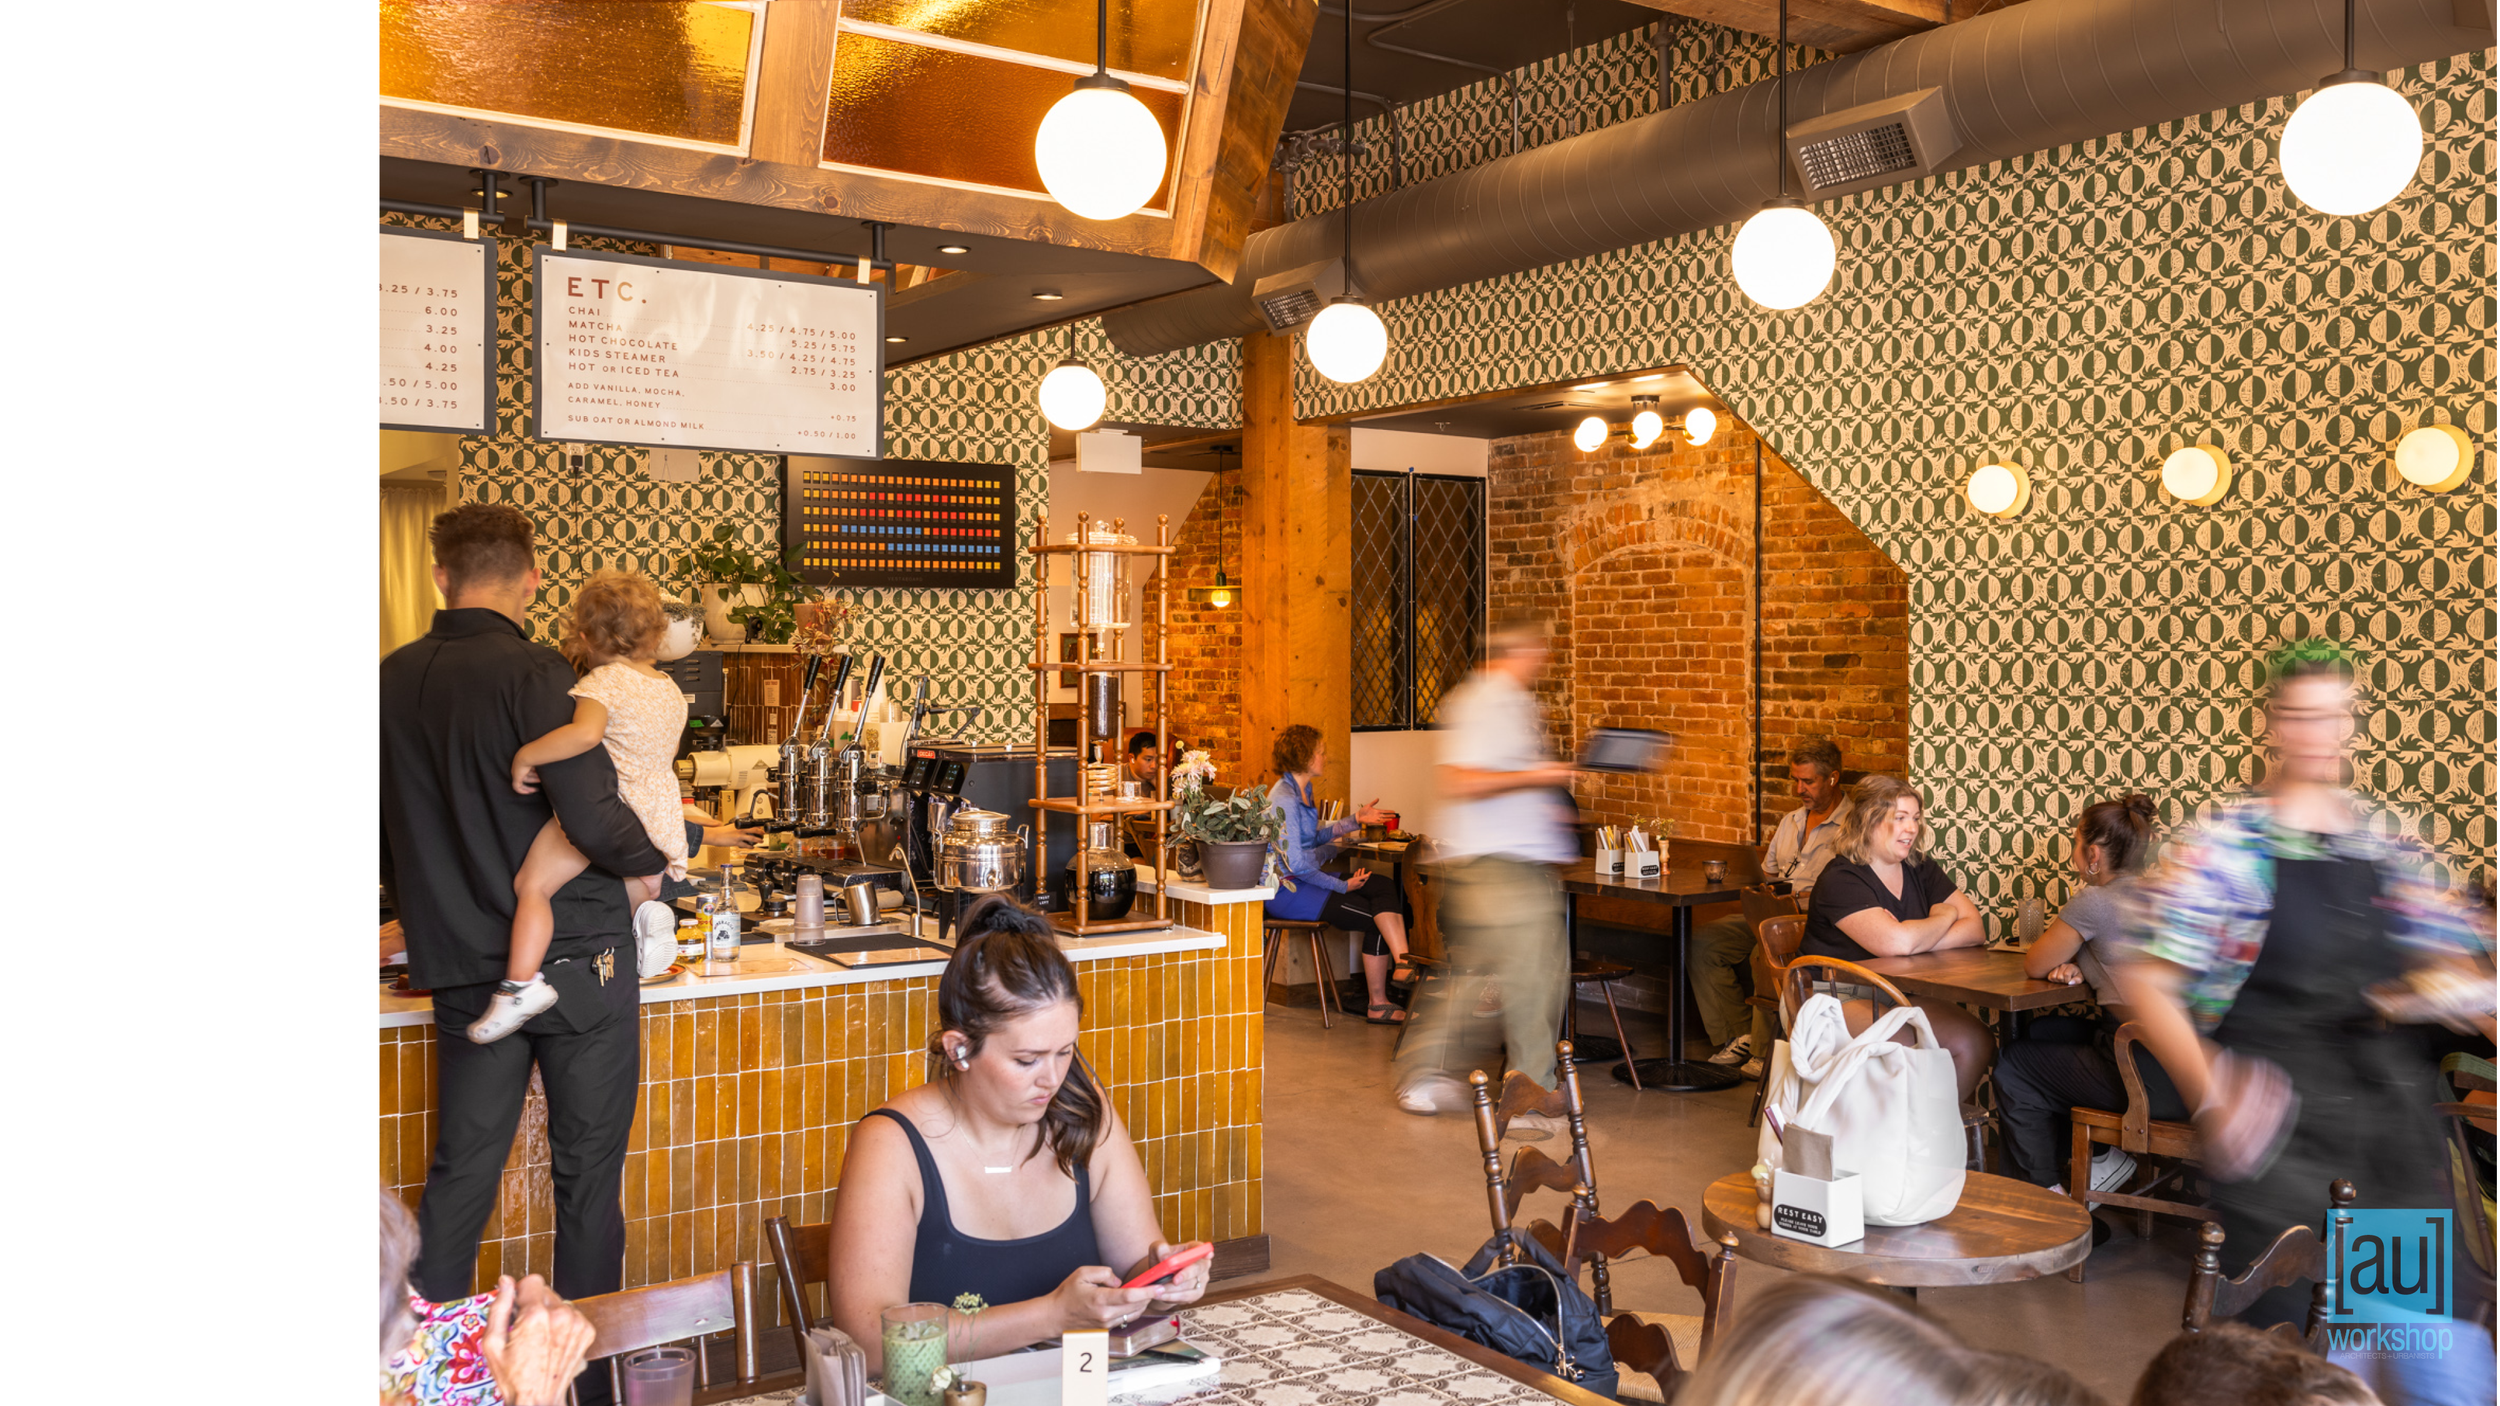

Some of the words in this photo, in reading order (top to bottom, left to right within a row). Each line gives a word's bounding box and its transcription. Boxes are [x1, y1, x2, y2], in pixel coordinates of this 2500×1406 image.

[426, 288, 458, 298] 3.75
[568, 277, 647, 303] ETC.
[425, 306, 458, 316] 6.00
[426, 325, 457, 335] 3.25
[568, 307, 600, 316] CHAI
[746, 323, 775, 332] 4.25
[790, 327, 816, 336] 4.75
[829, 331, 856, 340] 5.00
[568, 321, 623, 331] MATCHA
[791, 340, 817, 349] 5.25
[831, 344, 856, 353] 5.75
[424, 344, 457, 353] 4.00
[568, 335, 596, 343] HOT
[601, 337, 678, 350] CHOCOLATE
[747, 350, 775, 358] 3.50
[790, 354, 816, 362] 4.25
[830, 357, 856, 366] 4.75
[425, 362, 457, 372] 4.25
[568, 348, 600, 357] KIDS
[605, 351, 666, 363] STEAMER
[791, 366, 816, 375] 2.75
[830, 370, 856, 378] 3.25
[568, 363, 596, 371] HOT
[621, 366, 650, 375] ICED
[655, 369, 679, 378] TEA
[829, 383, 856, 391] 3.00
[425, 381, 457, 390] 5.00
[427, 399, 457, 409] 3.75
[634, 419, 677, 428] ALMOND
[1778, 1207, 1799, 1217] REST
[1802, 1213, 1823, 1223] EASY
[1080, 1352, 1092, 1372] 2
